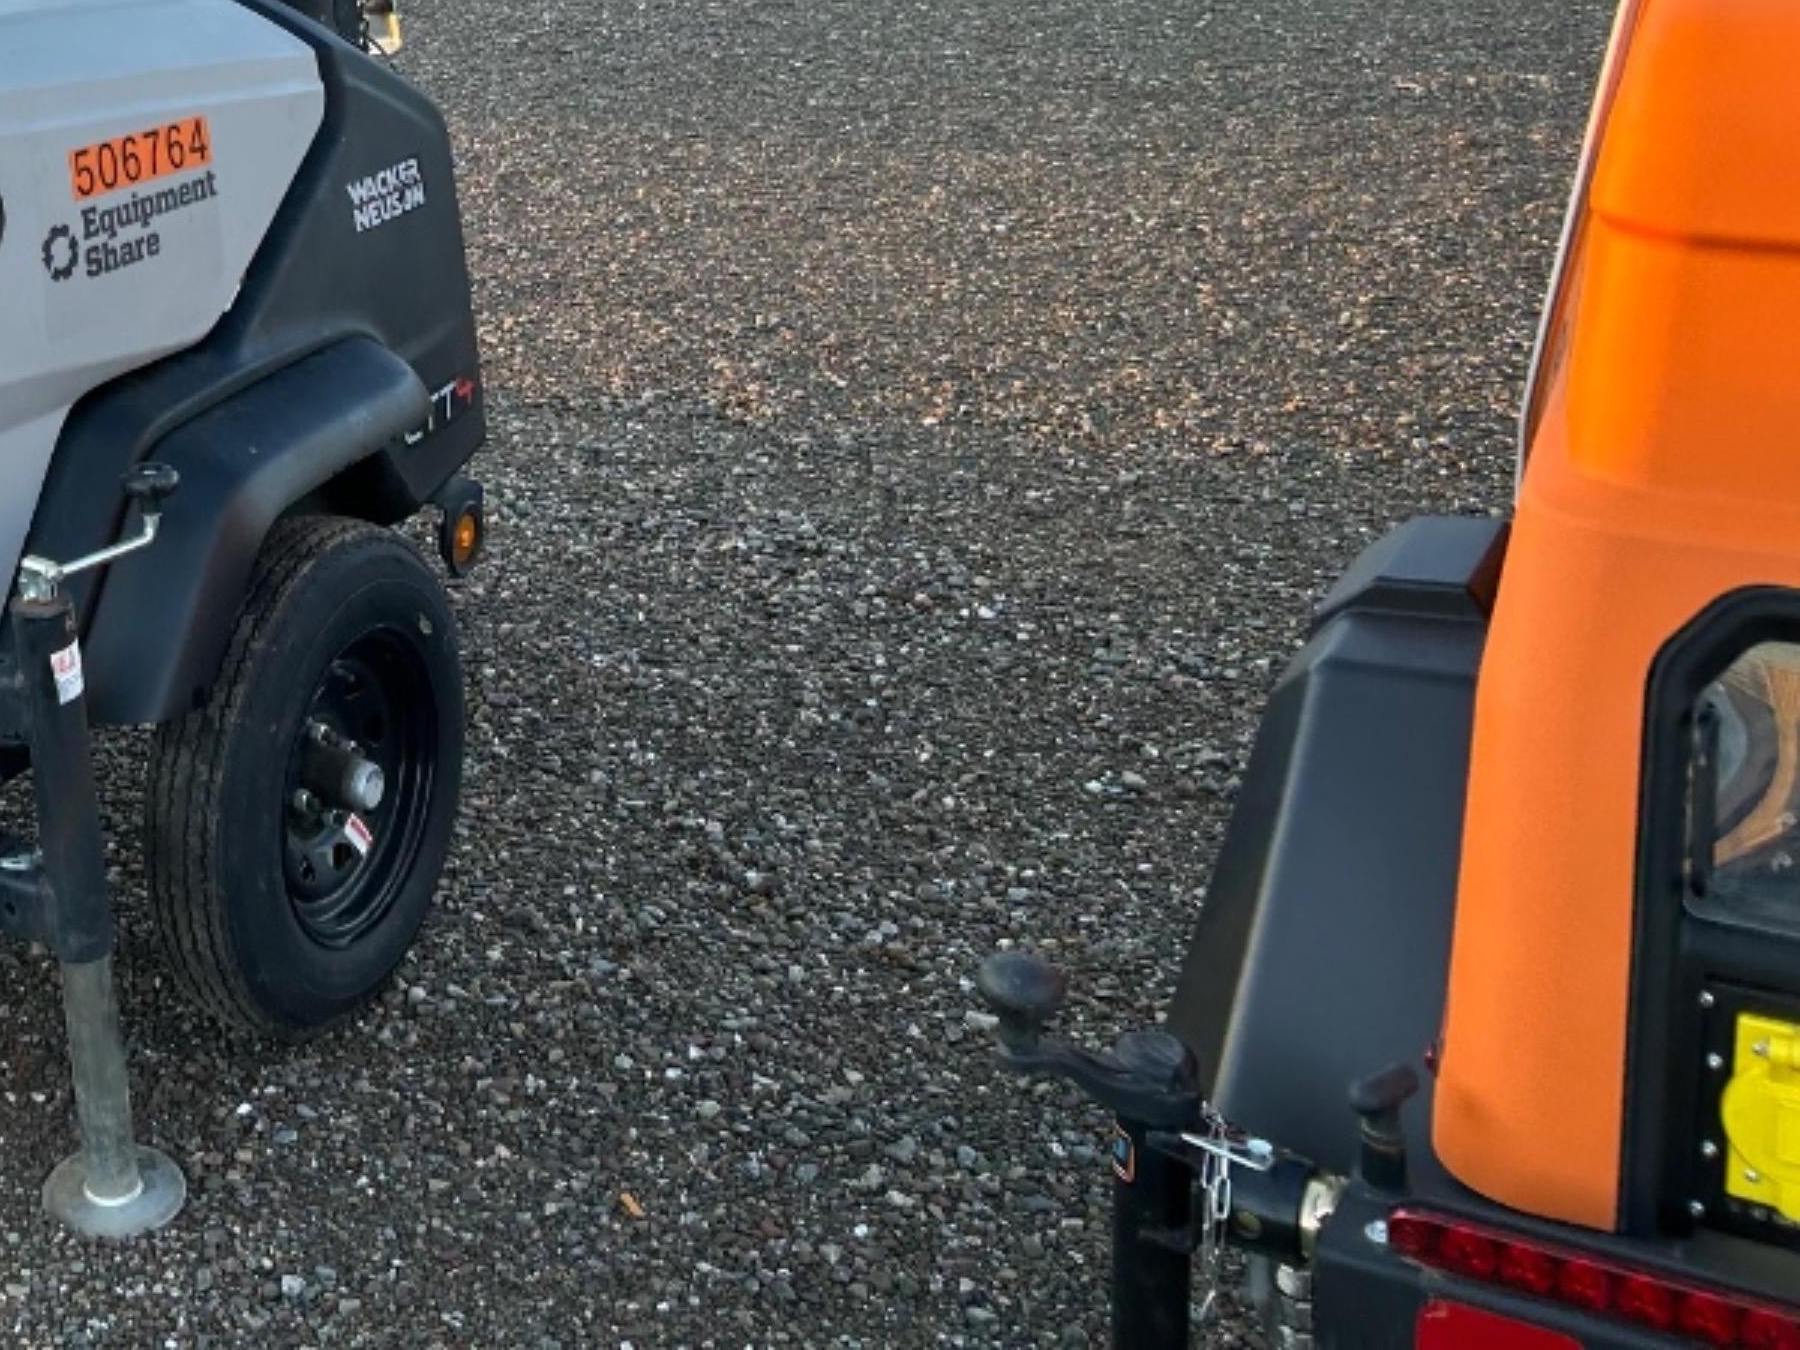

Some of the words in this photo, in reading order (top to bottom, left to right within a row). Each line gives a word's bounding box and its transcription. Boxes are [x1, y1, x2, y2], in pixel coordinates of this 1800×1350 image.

[73, 116, 208, 197] 506764
[347, 157, 421, 205] WACKER
[81, 169, 218, 240] Equipment
[352, 183, 426, 232] NEUSON
[84, 232, 161, 278] Share
